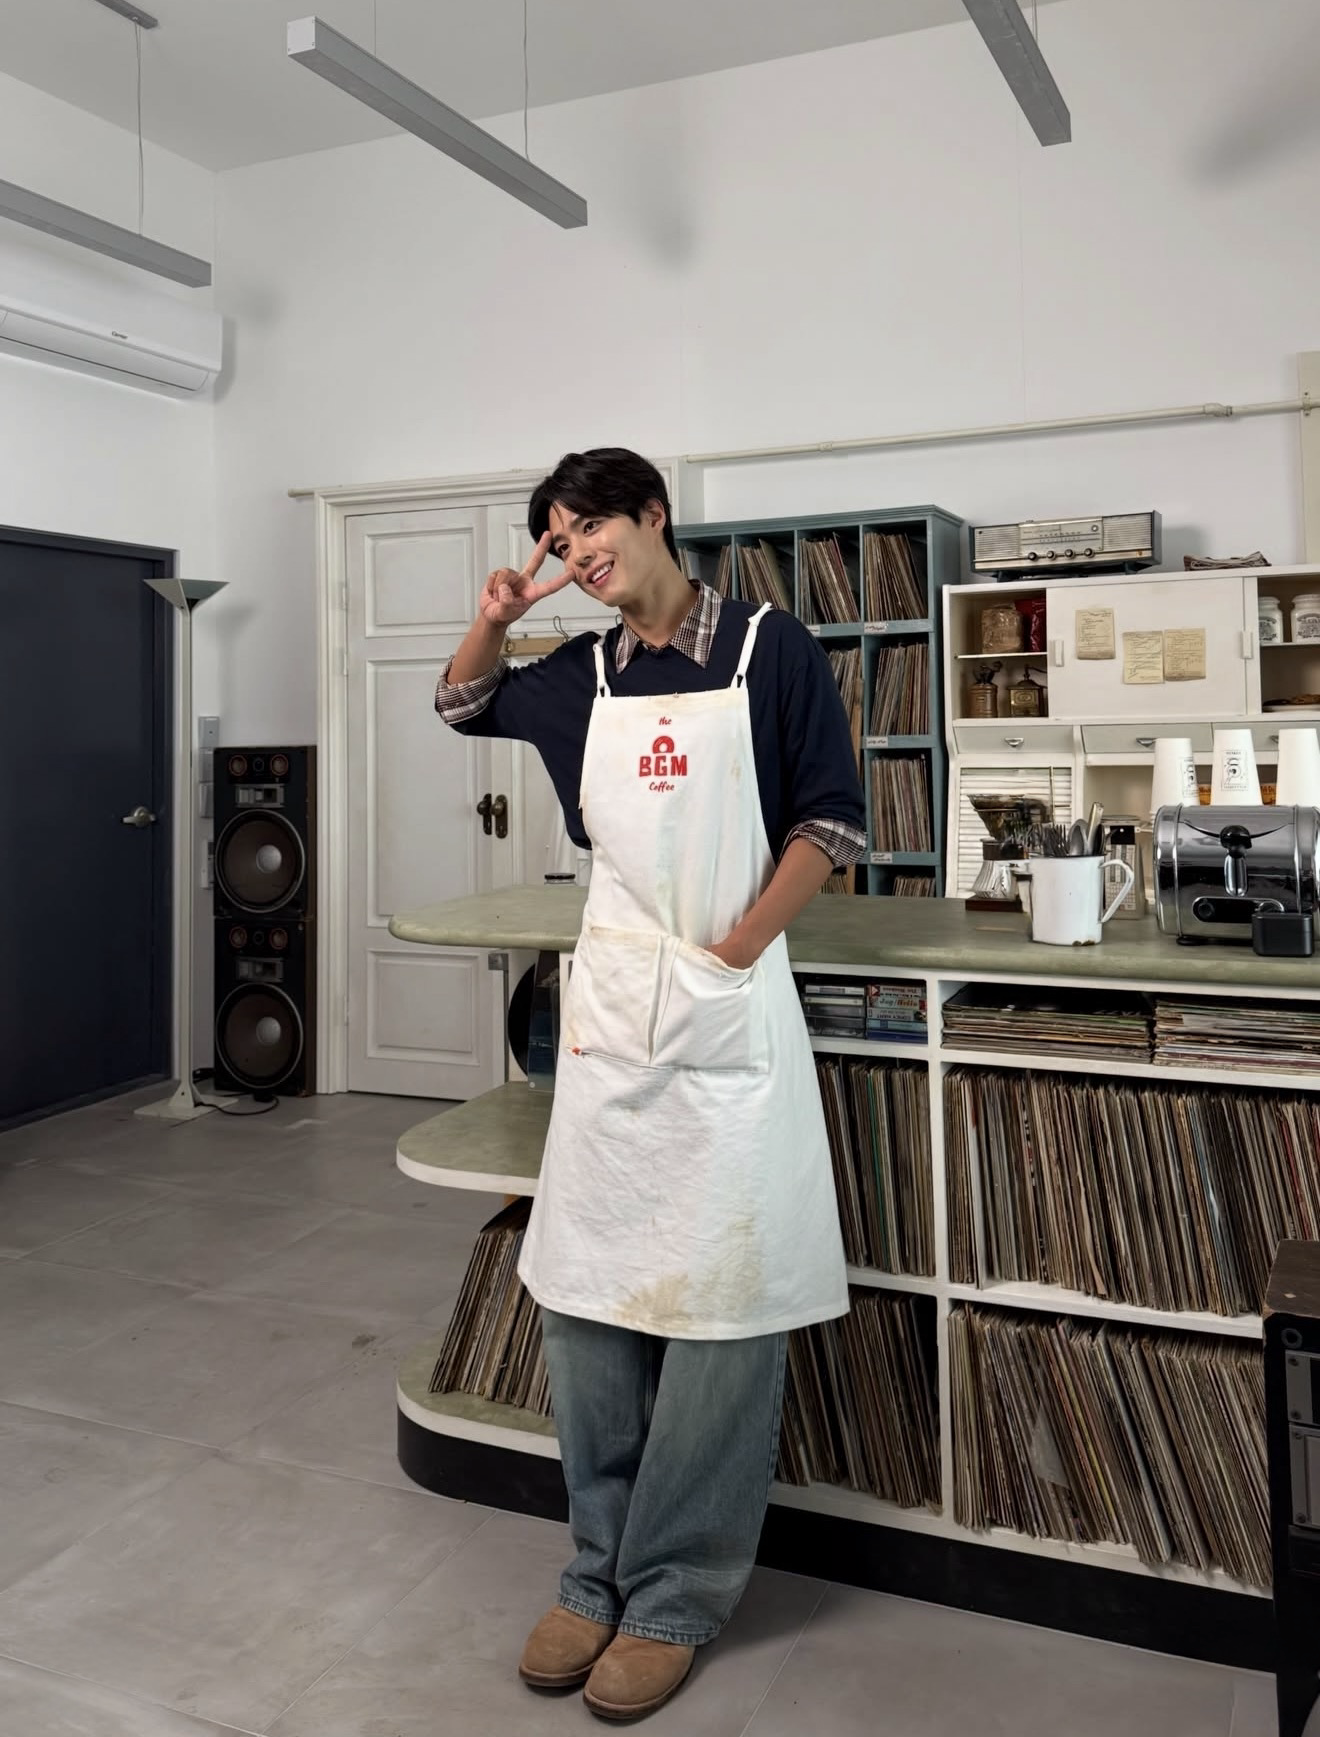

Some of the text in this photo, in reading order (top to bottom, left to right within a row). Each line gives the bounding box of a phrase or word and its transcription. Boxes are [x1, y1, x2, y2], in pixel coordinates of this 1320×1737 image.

[659, 716, 672, 726] the
[639, 754, 688, 777] BGM
[648, 780, 675, 793] Coffee
